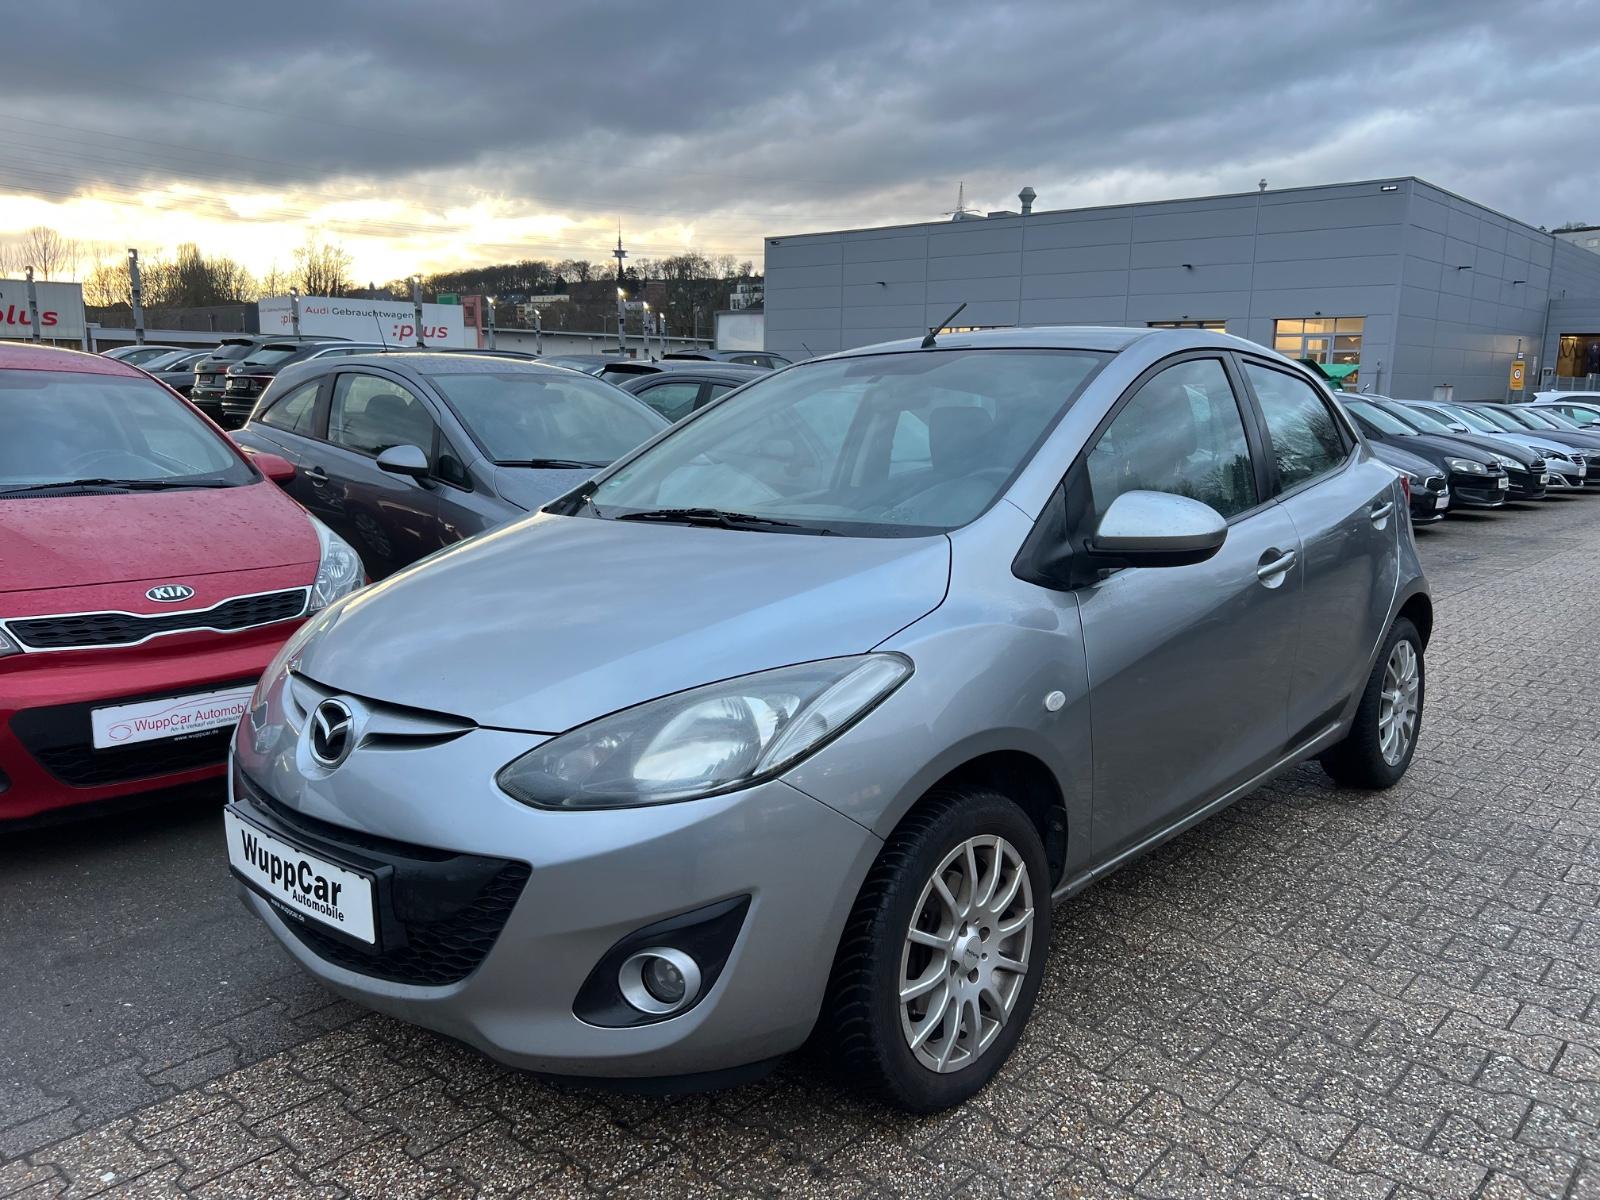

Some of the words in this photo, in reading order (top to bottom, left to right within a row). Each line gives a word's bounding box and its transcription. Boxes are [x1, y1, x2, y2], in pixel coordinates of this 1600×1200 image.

[0, 304, 58, 325] lus
[305, 306, 329, 315] Audi
[331, 307, 414, 320] Gebrauchtwagen
[392, 324, 448, 341] :pus
[153, 586, 189, 600] KIA
[134, 714, 192, 732] WuppCar
[241, 829, 342, 907] WuppCar
[292, 889, 345, 922] Automobile
